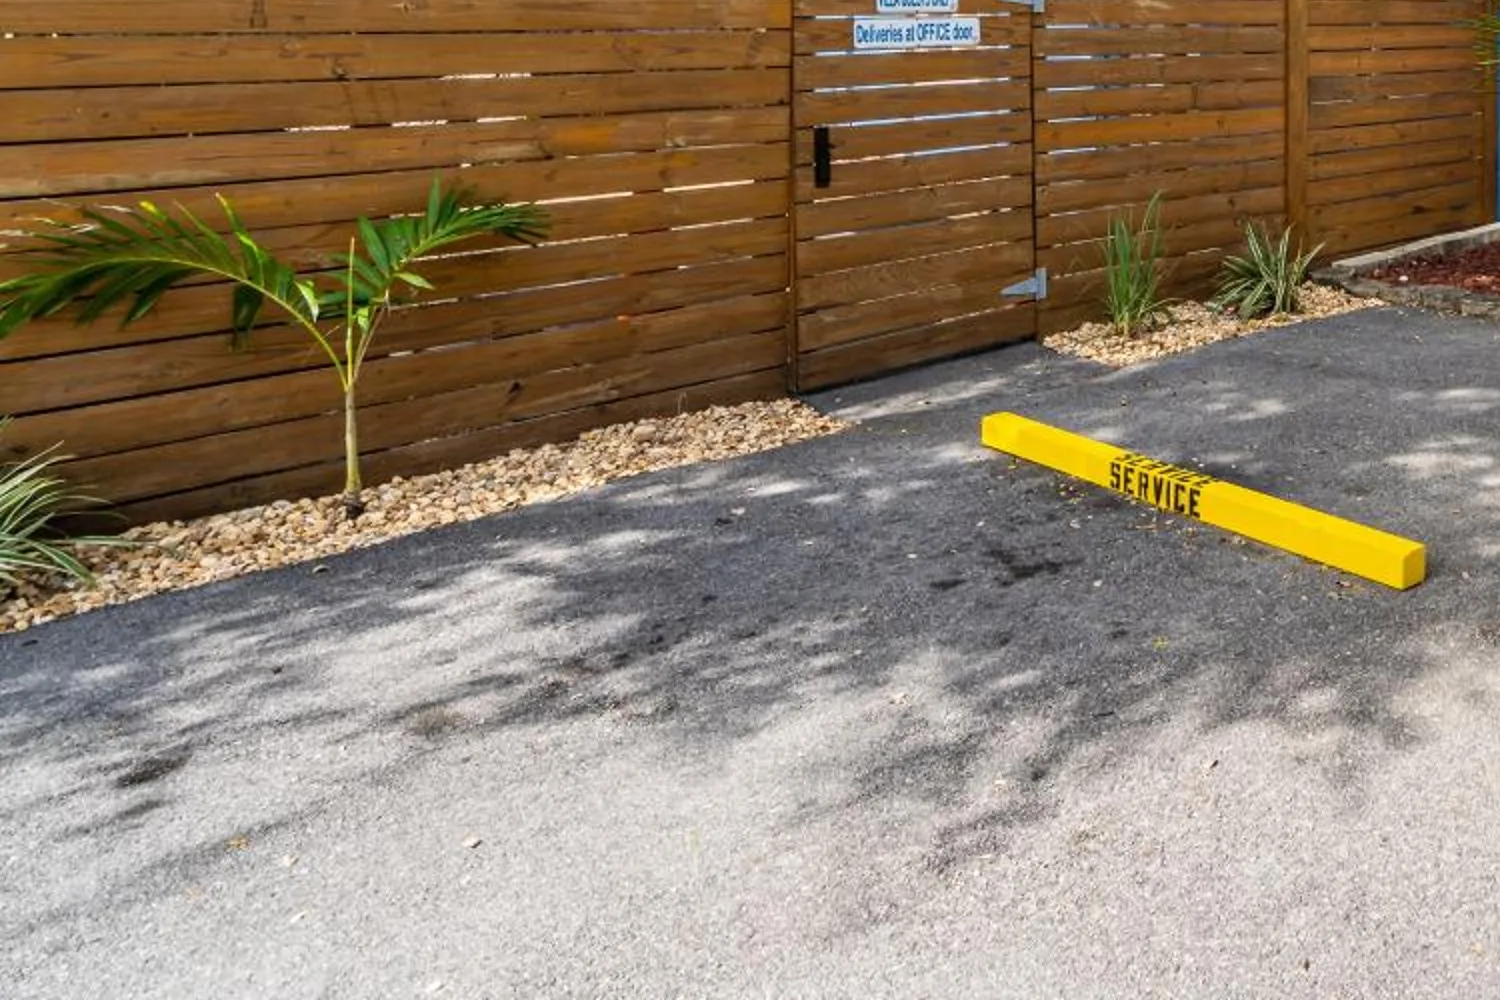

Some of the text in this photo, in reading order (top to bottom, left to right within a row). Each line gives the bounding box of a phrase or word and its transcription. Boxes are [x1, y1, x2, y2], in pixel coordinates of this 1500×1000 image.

[856, 25, 902, 43] Deliveries
[905, 26, 915, 42] at
[917, 23, 951, 40] OFFICE
[1110, 462, 1200, 517] SERVICE
